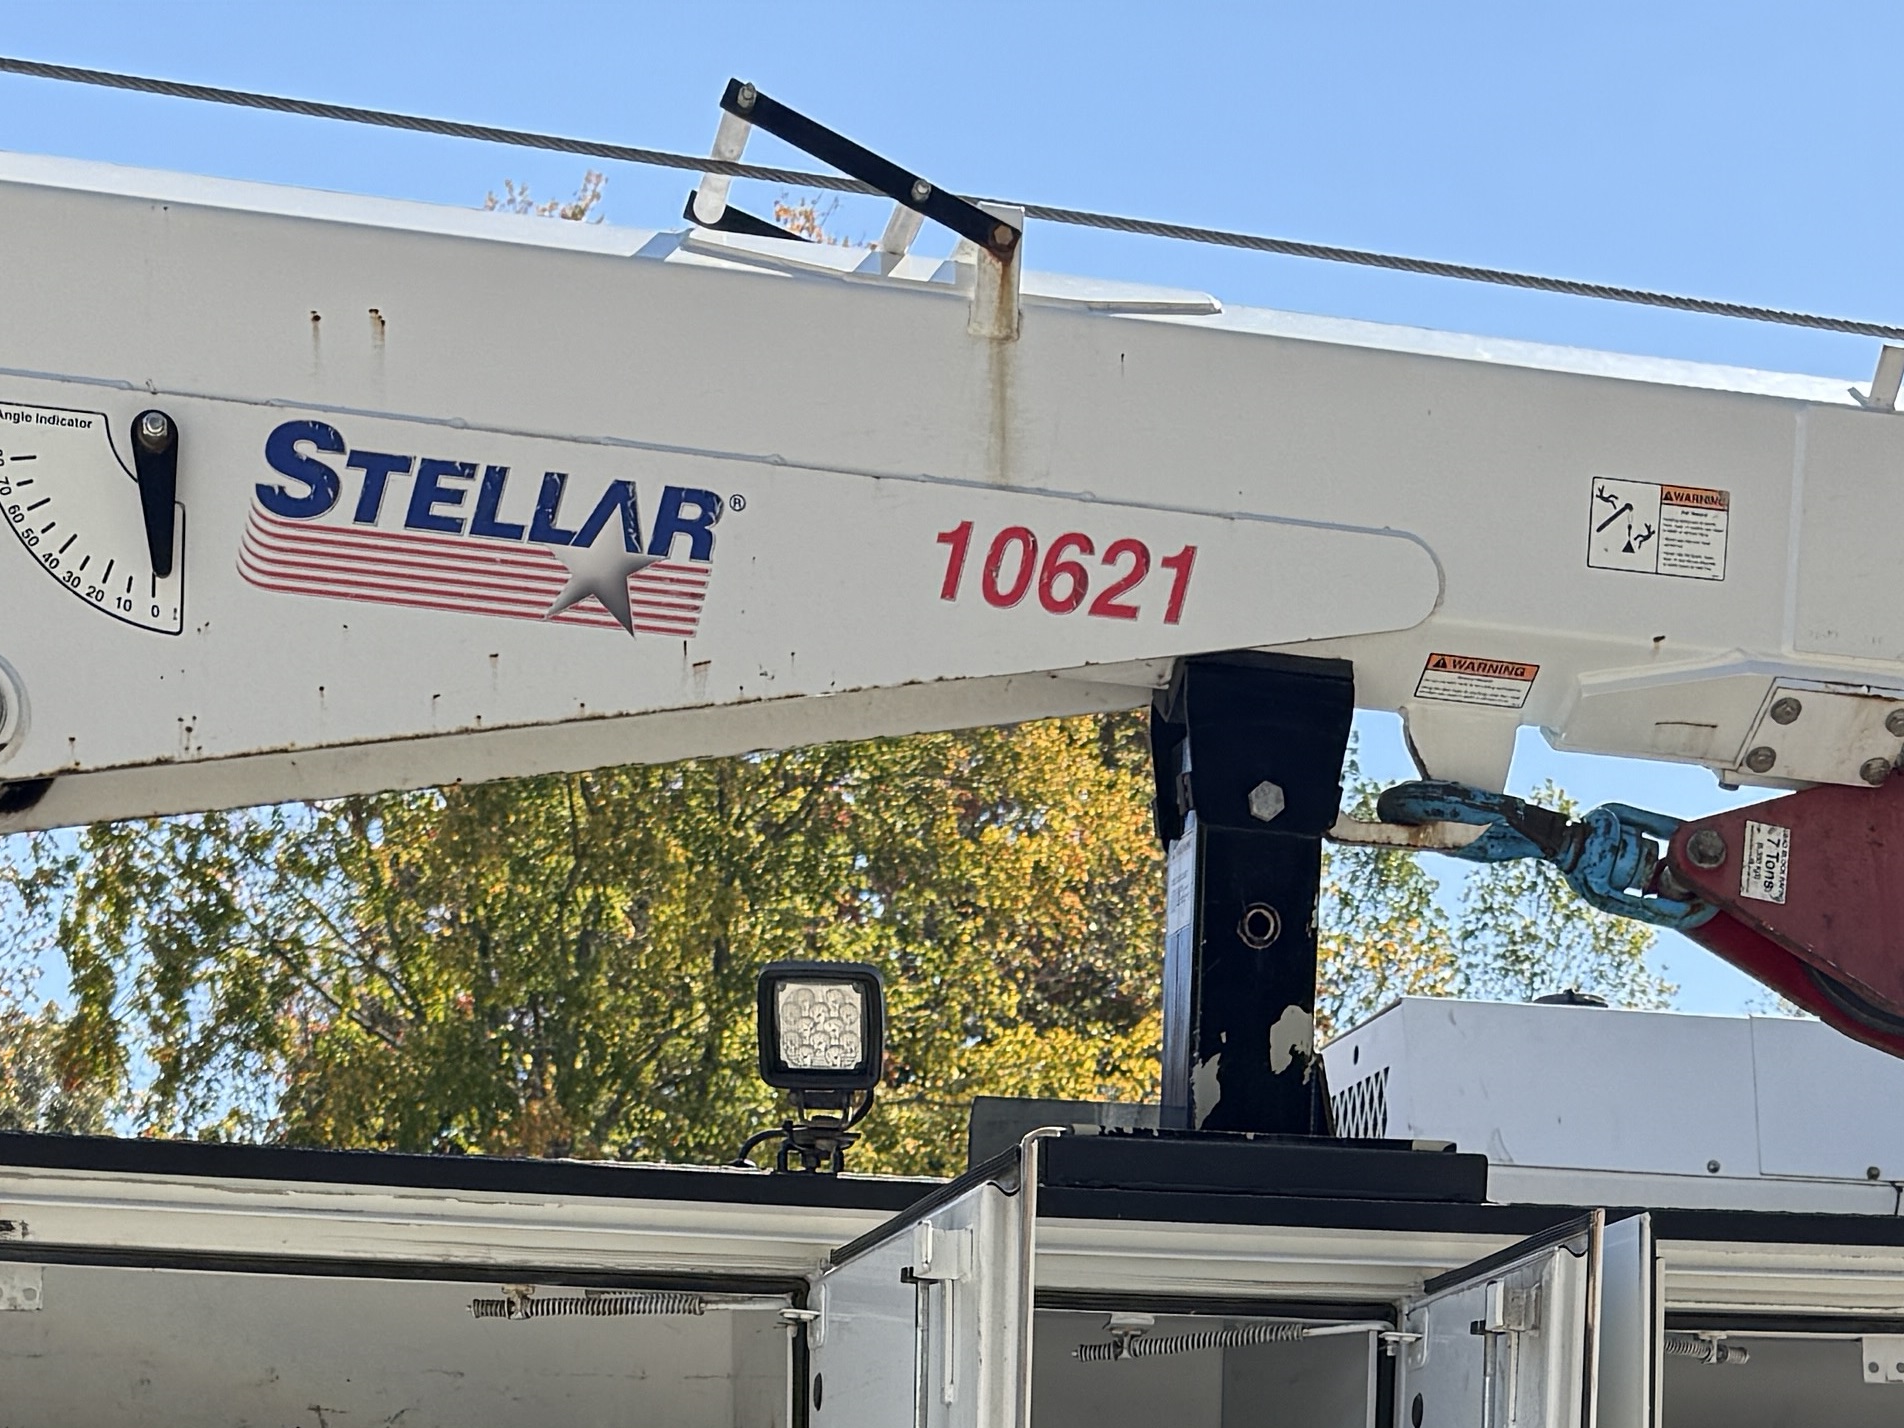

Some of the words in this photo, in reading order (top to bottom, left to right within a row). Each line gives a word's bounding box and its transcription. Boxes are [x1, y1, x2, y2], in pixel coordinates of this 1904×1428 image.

[35, 413, 93, 429] Indicator
[254, 419, 724, 563] STELLAR
[8, 504, 25, 524] 60
[21, 529, 40, 547] 50
[42, 552, 61, 570] 40
[62, 570, 81, 589] 30
[85, 585, 105, 602] 20
[116, 596, 133, 612] 10
[151, 605, 160, 618] 0
[935, 519, 1198, 625] 10621
[1451, 658, 1526, 677] WARNING
[1767, 838, 1781, 849] 7
[1763, 853, 1780, 890] Tons
